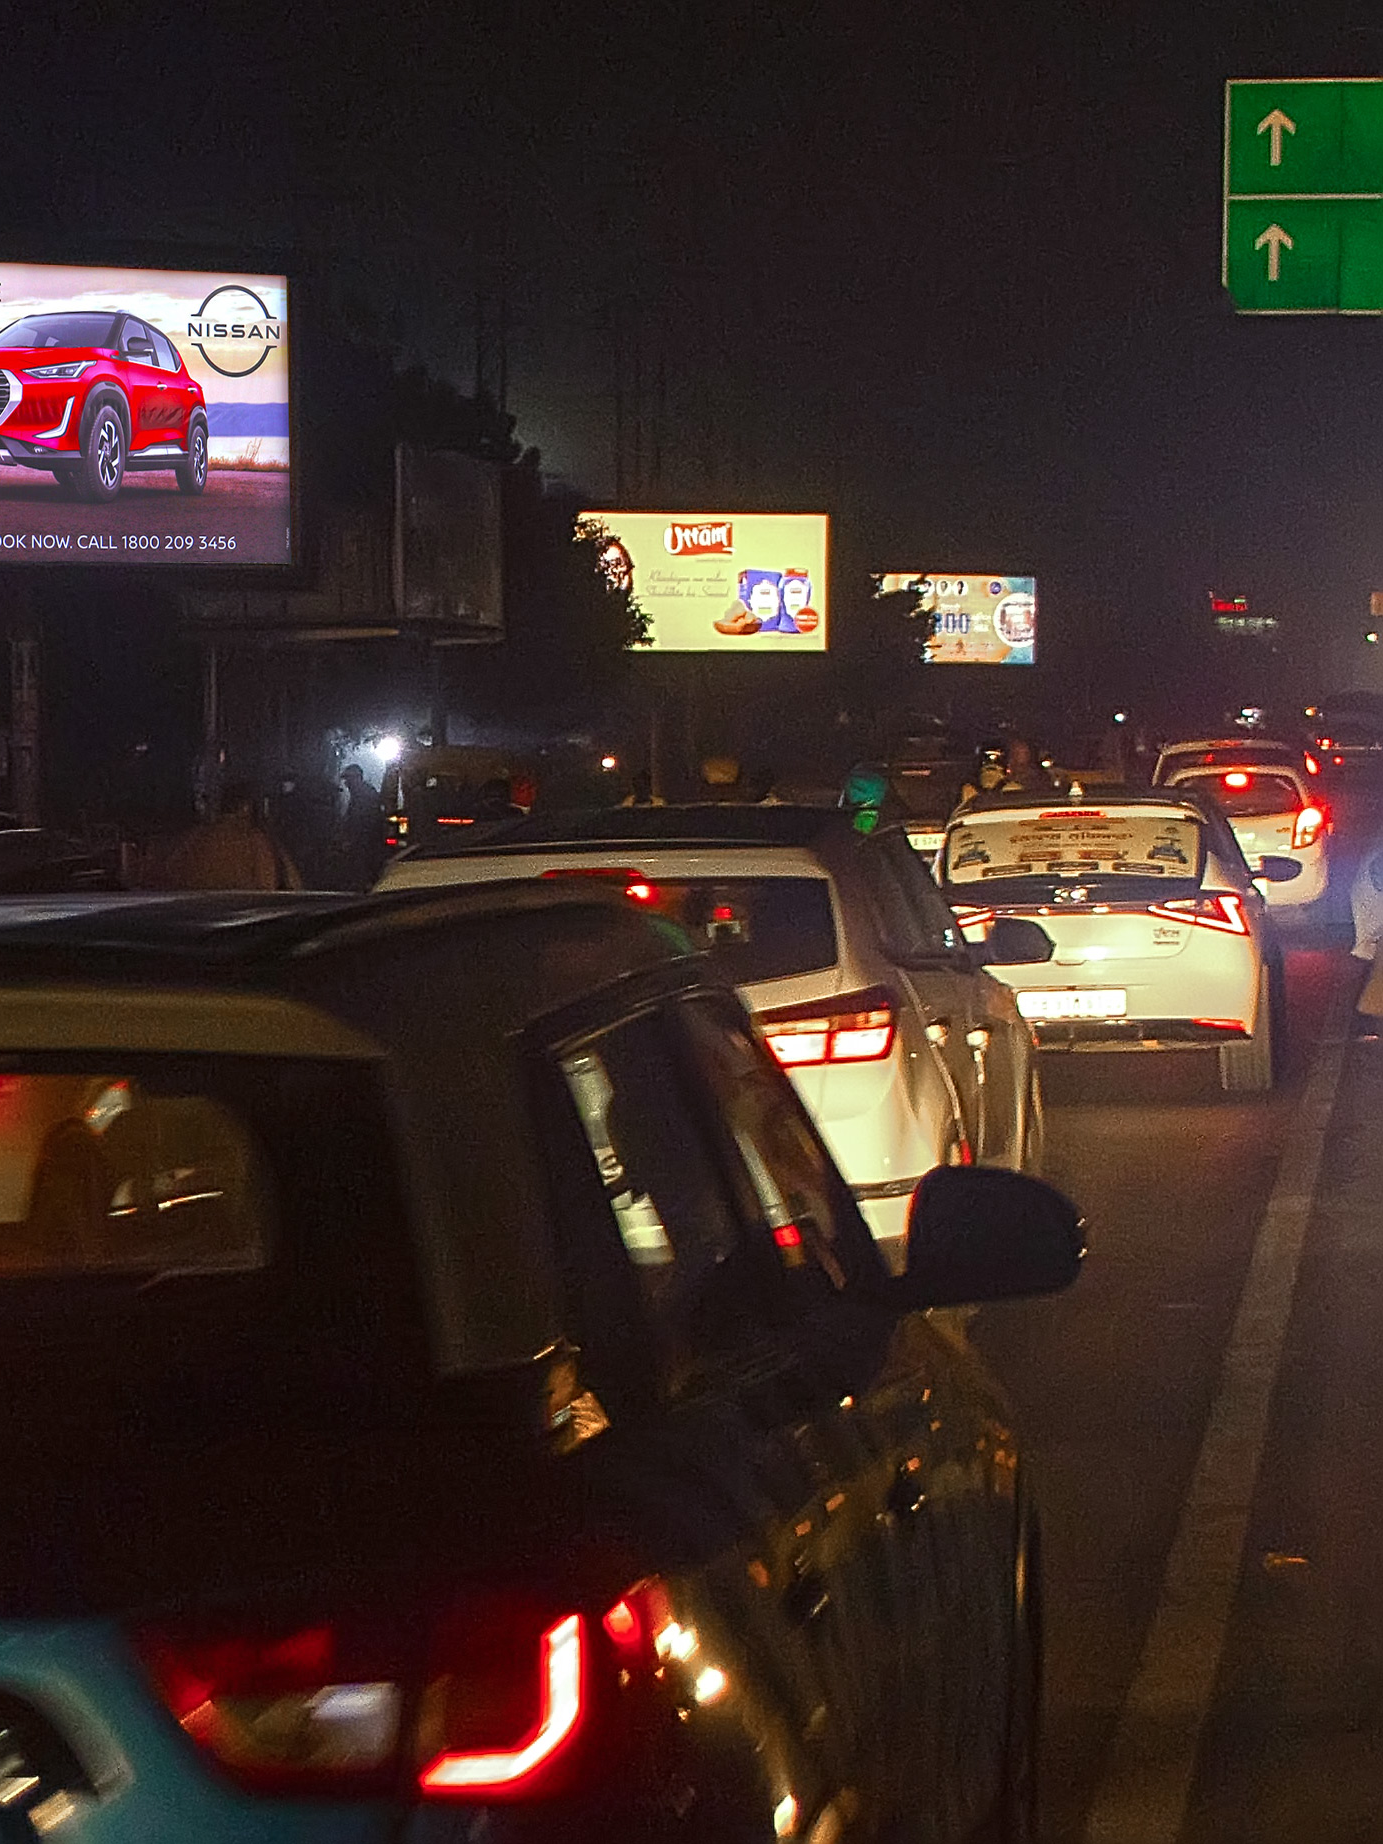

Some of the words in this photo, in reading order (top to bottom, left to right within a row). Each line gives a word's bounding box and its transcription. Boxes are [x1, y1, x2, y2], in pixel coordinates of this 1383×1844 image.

[187, 322, 280, 340] NISSAN
[31, 534, 73, 549] NOW.
[77, 535, 118, 549] CALL
[122, 535, 160, 550] 1800
[164, 535, 194, 550] 209
[198, 535, 237, 550] 3456
